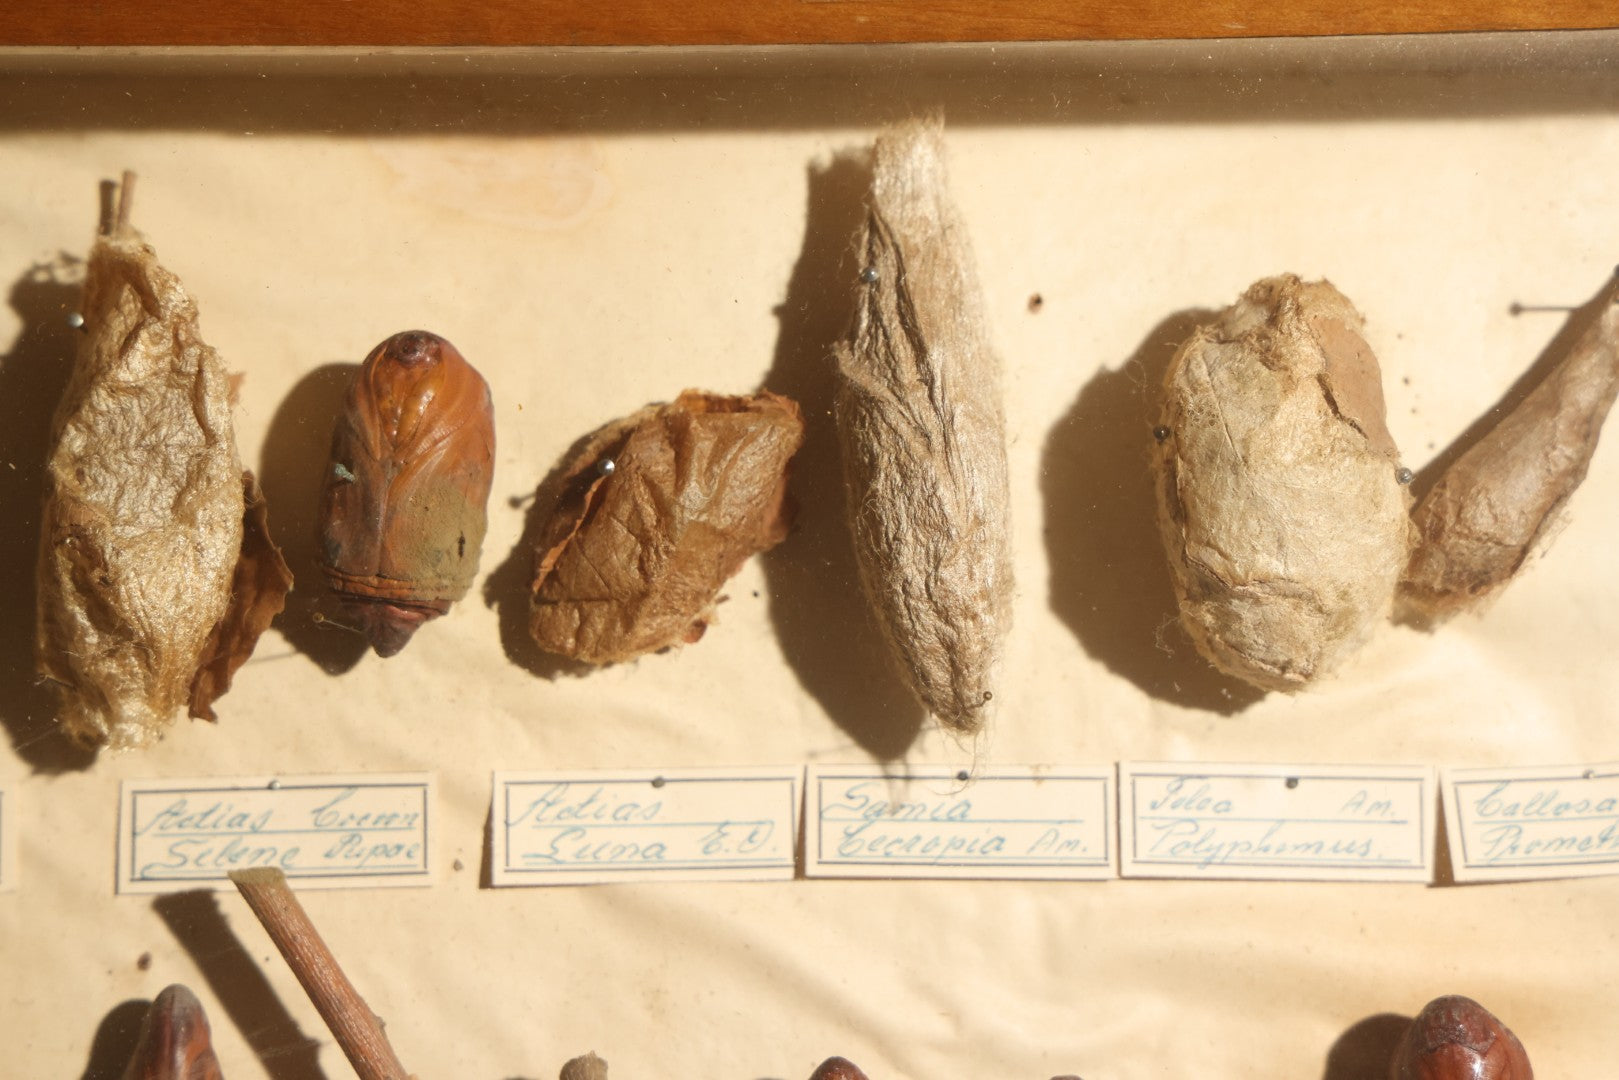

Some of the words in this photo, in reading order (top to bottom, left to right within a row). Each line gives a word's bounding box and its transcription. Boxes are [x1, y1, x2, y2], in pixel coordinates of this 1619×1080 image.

[820, 782, 972, 822] Samia
[140, 838, 301, 879] Selene
[521, 825, 668, 864] Luna
[837, 819, 1007, 863] Cecropia
[1027, 828, 1088, 856] Am.
